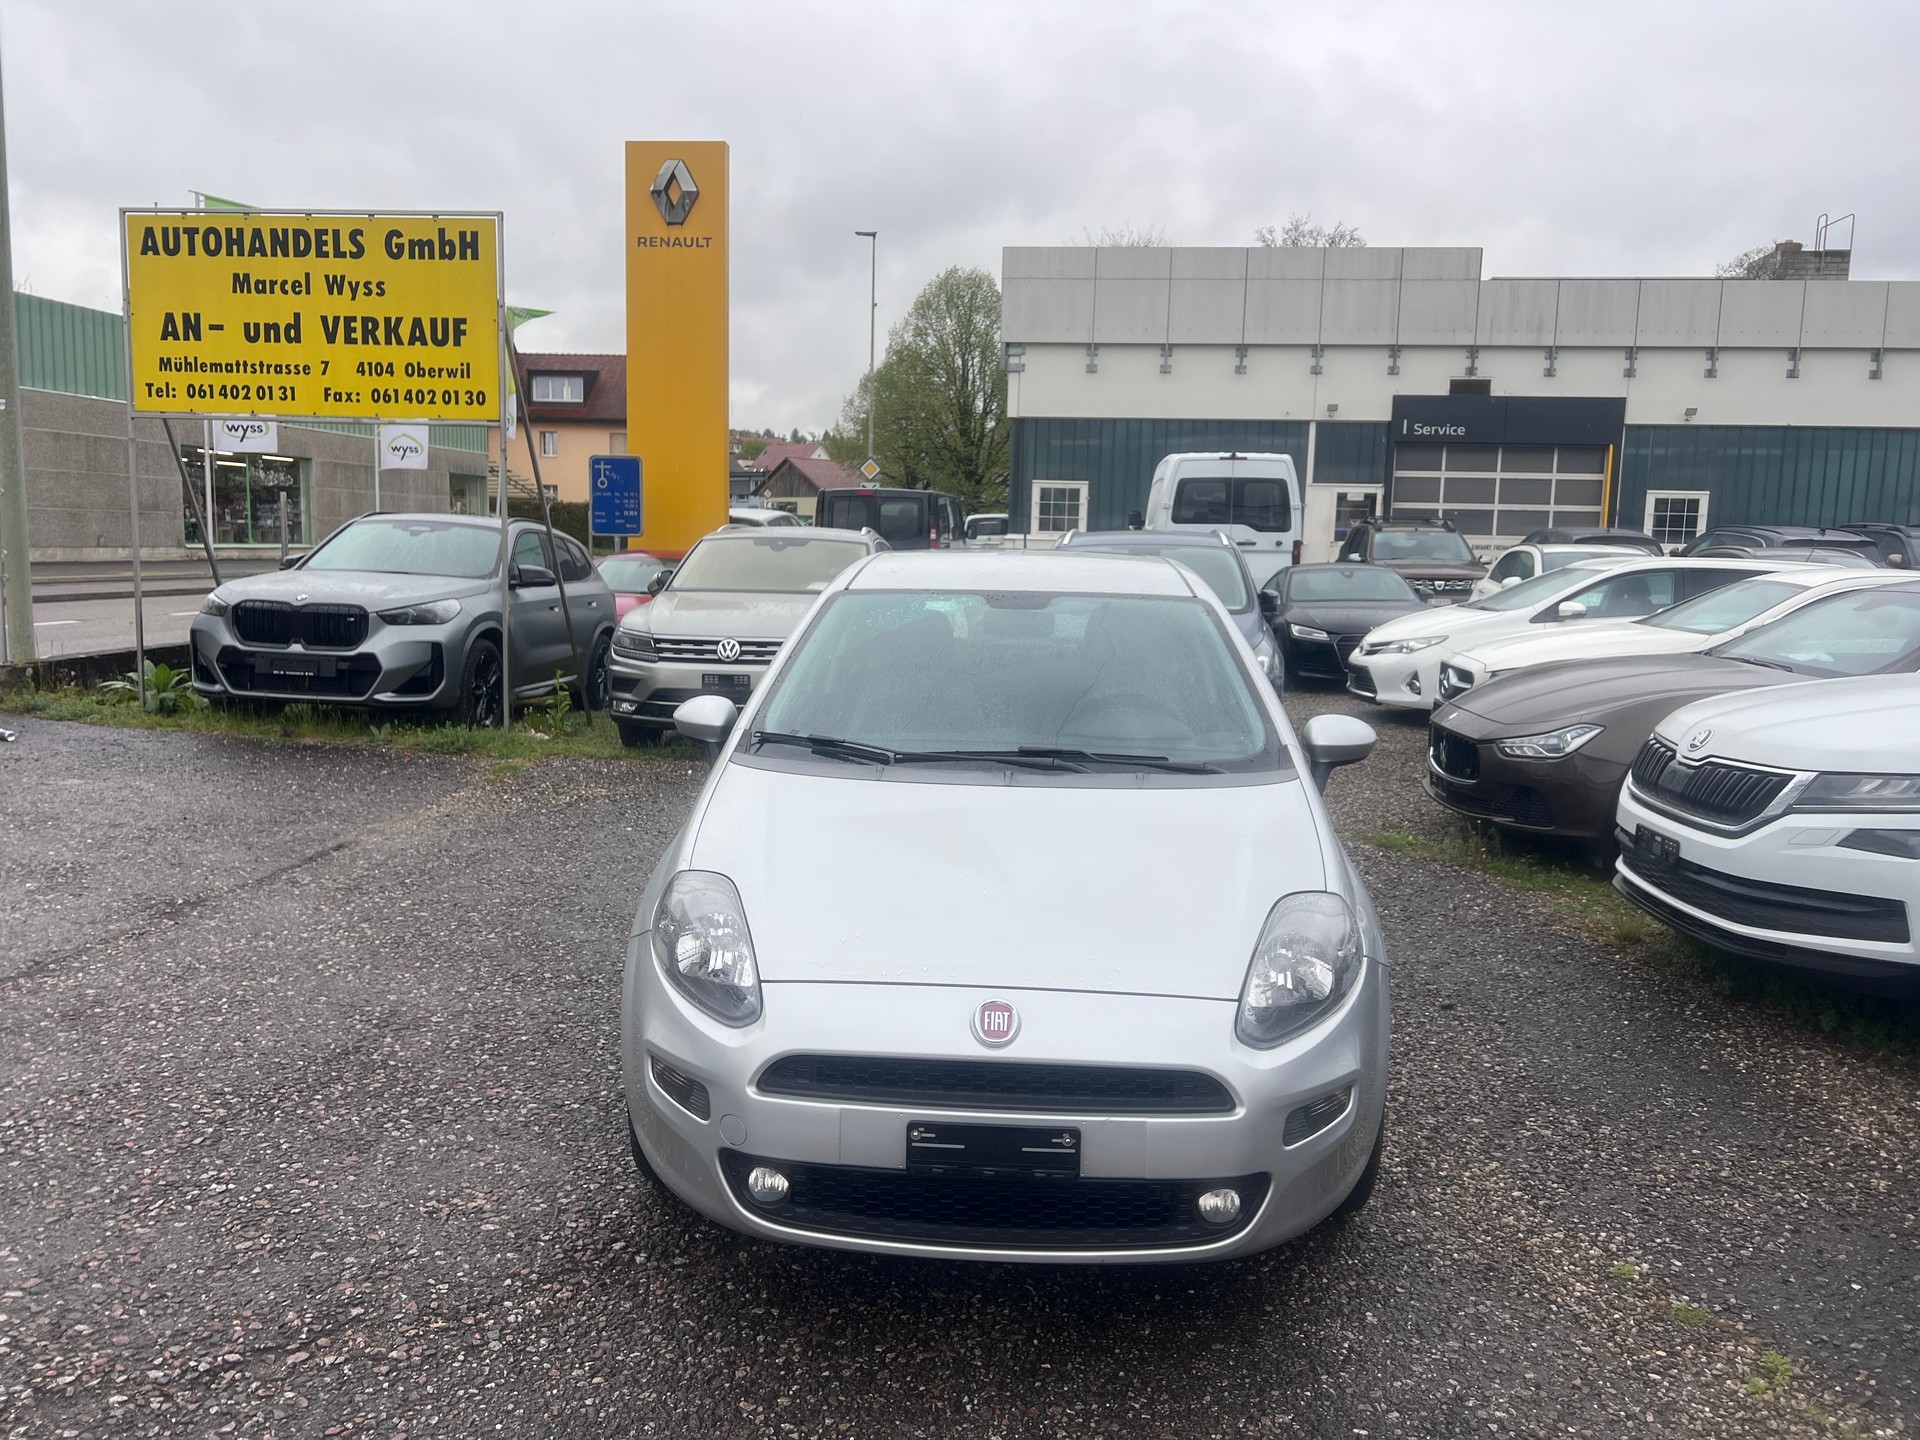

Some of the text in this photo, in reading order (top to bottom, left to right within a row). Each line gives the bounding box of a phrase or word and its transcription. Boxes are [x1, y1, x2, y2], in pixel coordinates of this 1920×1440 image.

[140, 226, 480, 261] AUTOHANDELS GmbH
[637, 236, 713, 248] RENAULT
[232, 271, 386, 301] Marcel Wyss
[243, 311, 302, 344] und
[320, 315, 468, 347] VERKAUF
[159, 356, 471, 379] Mühlemattstrasse 7 4104 Oberwil
[145, 382, 177, 399] Tel:
[323, 387, 361, 404] Fax:
[226, 424, 264, 442] wyss
[1413, 423, 1466, 436] Service
[391, 446, 420, 460] wyss
[984, 1010, 1011, 1032] FIAT
